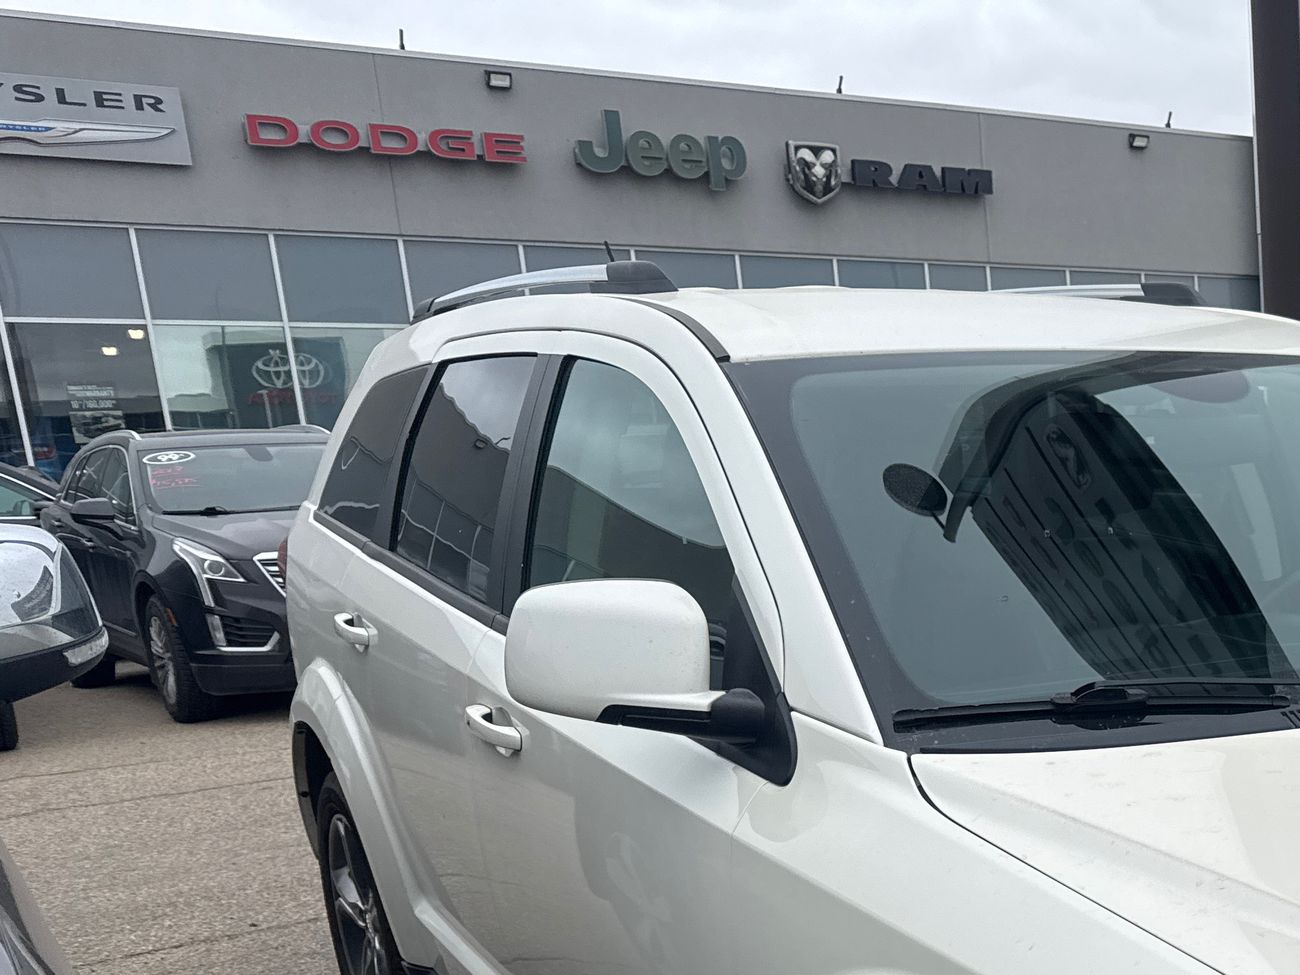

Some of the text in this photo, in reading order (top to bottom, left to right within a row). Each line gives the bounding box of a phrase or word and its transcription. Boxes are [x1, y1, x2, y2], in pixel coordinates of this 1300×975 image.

[0, 83, 166, 113] SLER
[242, 113, 528, 163] DODGE
[575, 109, 747, 192] Jeep
[851, 158, 994, 195] RAM
